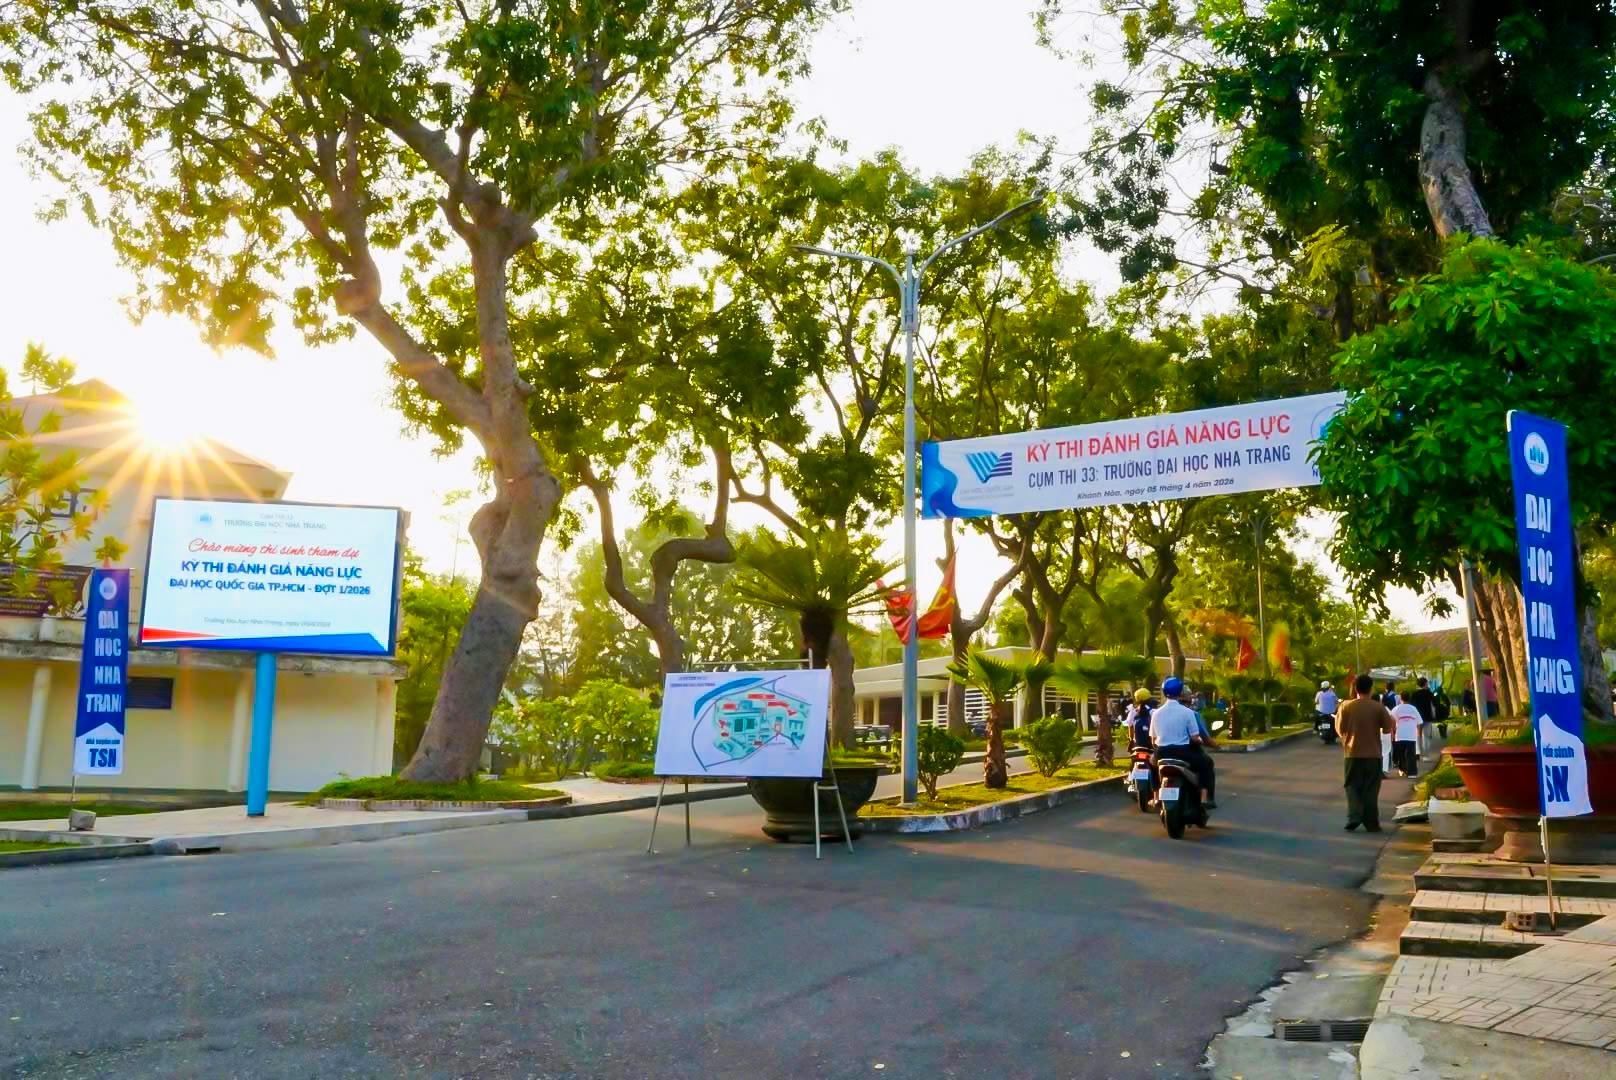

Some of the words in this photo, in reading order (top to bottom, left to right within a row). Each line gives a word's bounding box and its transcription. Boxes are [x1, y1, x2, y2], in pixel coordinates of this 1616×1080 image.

[1027, 440, 1050, 463] KỲ
[1055, 440, 1083, 460] THI
[1088, 432, 1140, 456] ĐÁNH
[1146, 424, 1179, 449] GIÁ
[1185, 421, 1241, 445] NĂNG
[1248, 414, 1291, 440] LỰC
[1028, 471, 1054, 490] CỤM
[1058, 469, 1076, 485] THI
[1081, 466, 1099, 483] 33:
[1104, 459, 1151, 481] TRƯỜNG
[1157, 457, 1178, 477] ĐẠI
[1183, 454, 1209, 474] HỌC
[1214, 450, 1241, 469] NHA
[1246, 444, 1291, 465] TRANG
[1193, 480, 1211, 488] năm
[1213, 478, 1234, 486] 2026
[307, 545, 340, 557] tham
[202, 561, 223, 573] THI
[227, 561, 266, 574] ĐÁNH
[269, 562, 292, 576] GIÁ
[295, 564, 334, 577] NĂNG
[337, 565, 362, 581] LỰC
[169, 578, 188, 590] ĐẠI
[190, 579, 212, 591] HỌC
[215, 577, 245, 590] QUỐC
[247, 581, 266, 591] GIA
[268, 582, 305, 592] TP.HCM
[314, 583, 336, 596] ĐỢT
[339, 584, 371, 595] 1/2026
[94, 637, 122, 659] HỌC
[94, 665, 121, 685] NHA
[89, 748, 117, 768] TSN
